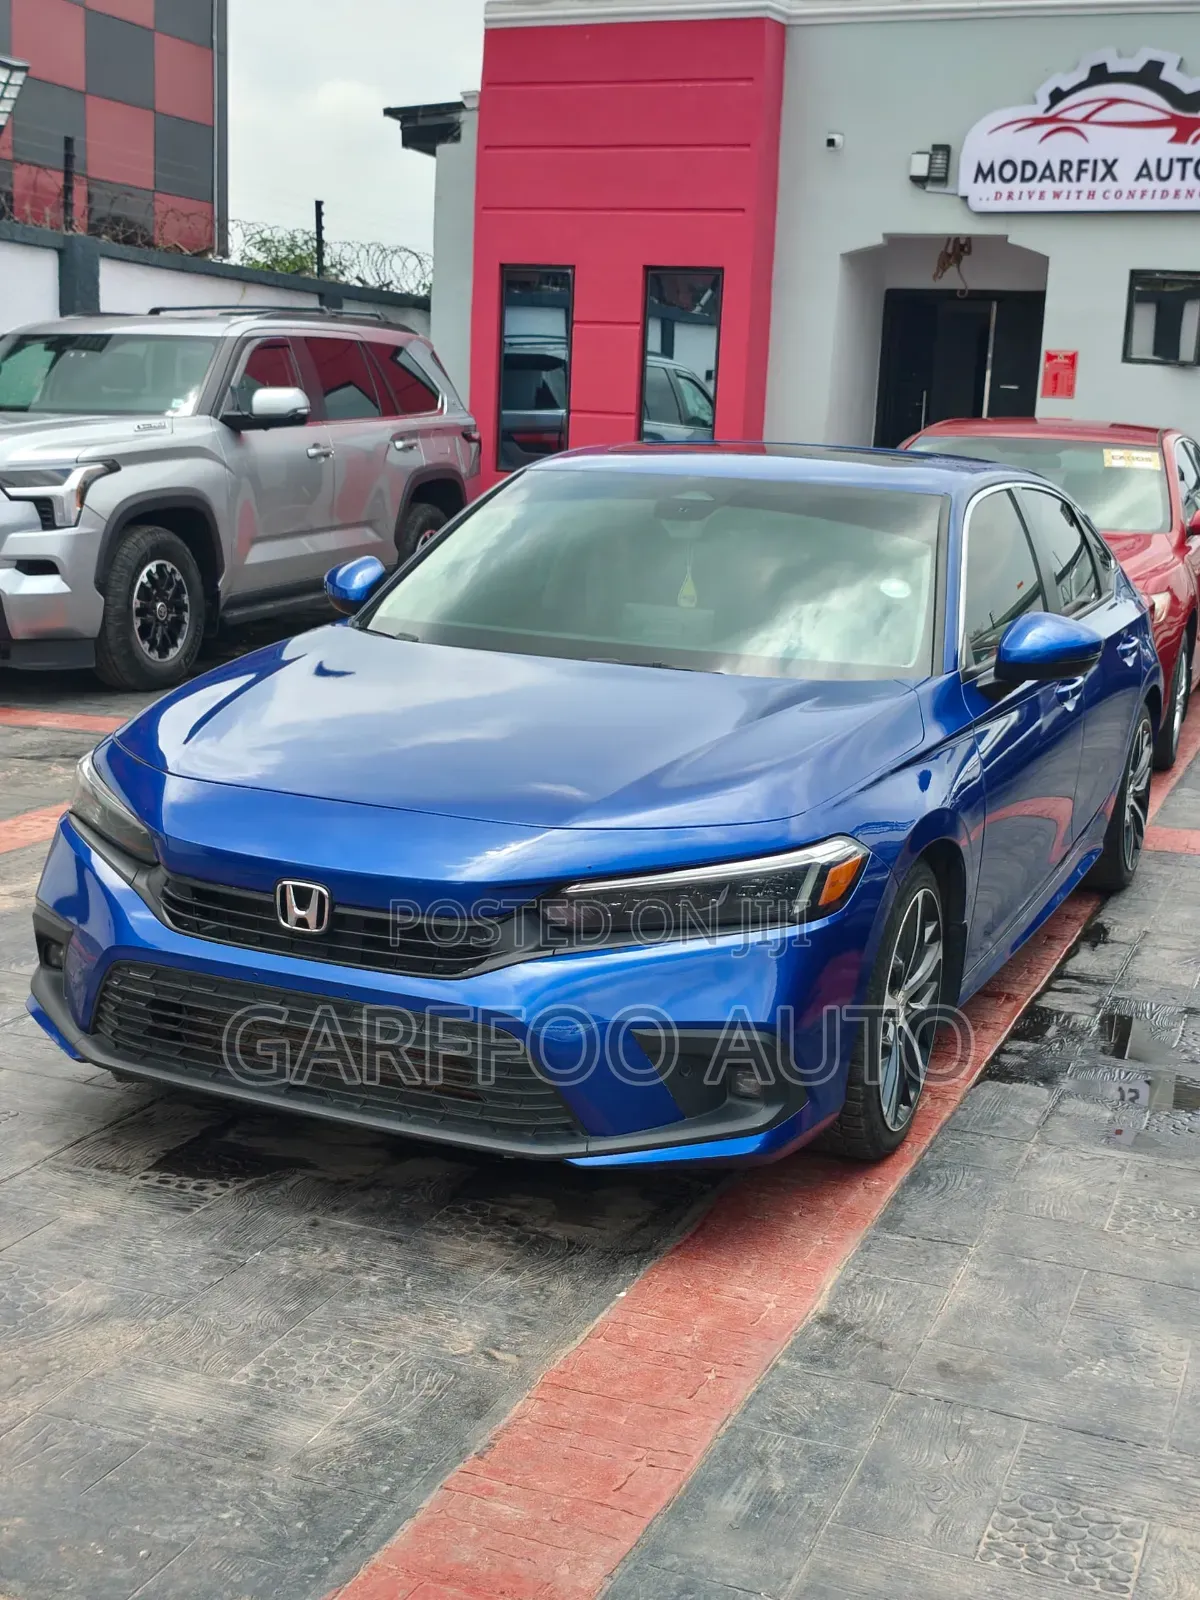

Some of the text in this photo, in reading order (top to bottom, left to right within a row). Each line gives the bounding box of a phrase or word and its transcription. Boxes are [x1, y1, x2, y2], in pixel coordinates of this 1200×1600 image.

[973, 158, 1119, 184] MODARFIX
[1052, 189, 1097, 201] WITH
[1102, 188, 1200, 201] CONFIDEN
